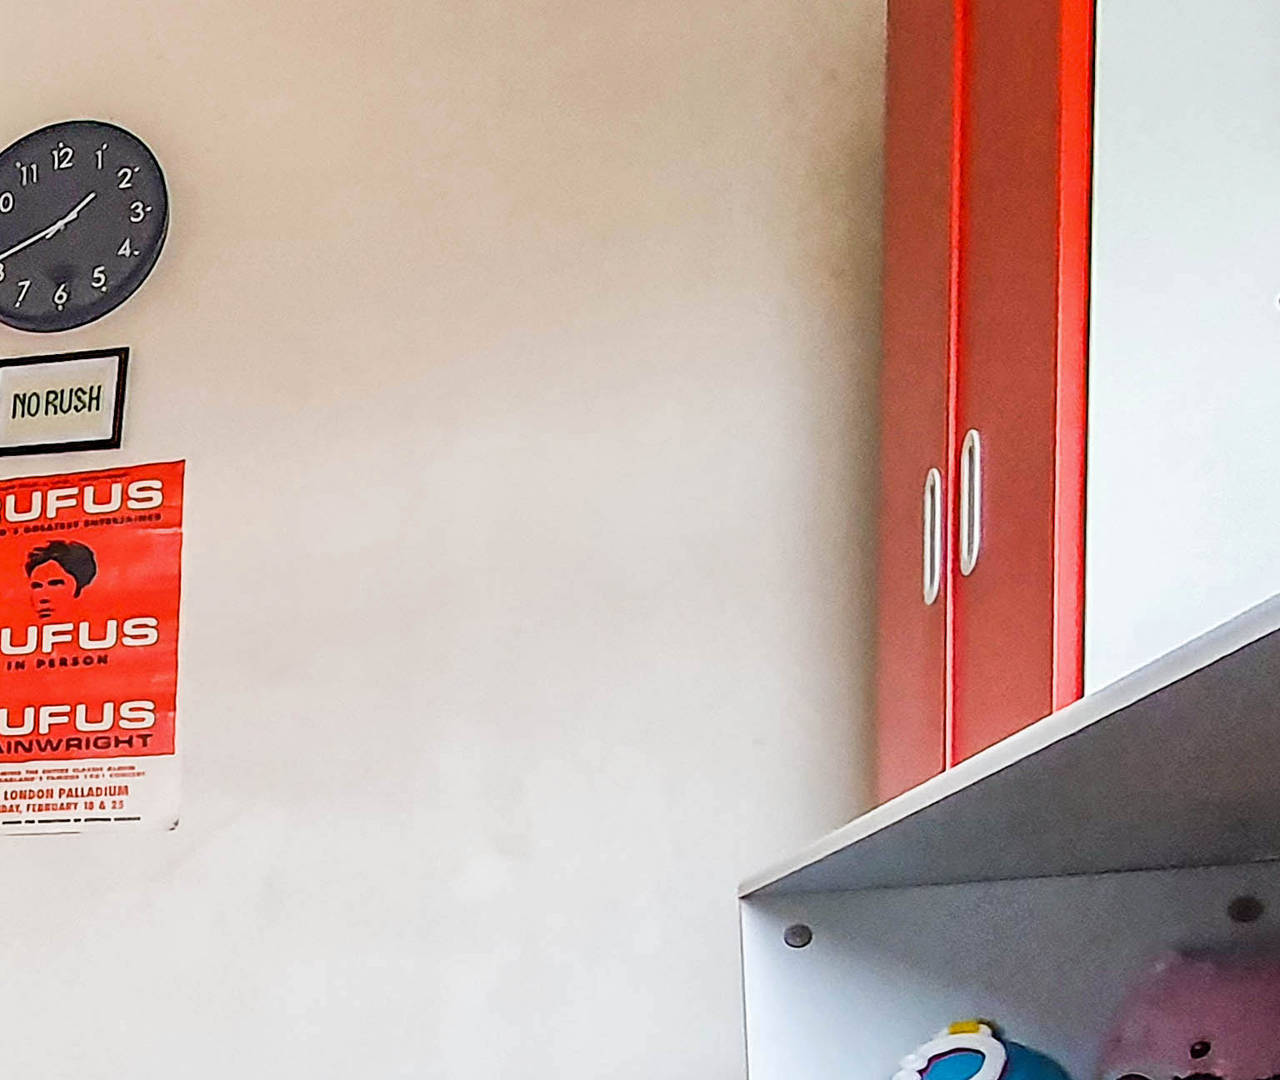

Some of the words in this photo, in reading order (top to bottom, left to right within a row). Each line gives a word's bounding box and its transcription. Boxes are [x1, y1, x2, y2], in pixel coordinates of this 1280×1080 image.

[52, 147, 74, 170] 12
[95, 150, 103, 170] 1
[20, 163, 38, 186] 11
[117, 168, 133, 189] 2
[130, 201, 146, 222] 3
[117, 238, 131, 258] 4
[91, 265, 106, 287] 5
[17, 280, 31, 303] 7
[54, 283, 68, 305] 6
[12, 391, 40, 419] NO
[44, 385, 102, 416] RUSH
[7, 660, 26, 670] IN
[36, 654, 108, 669] PERSON
[3, 788, 55, 801] LONDON
[58, 785, 129, 799] PALLADIUM
[26, 802, 78, 813] FEBRUARY
